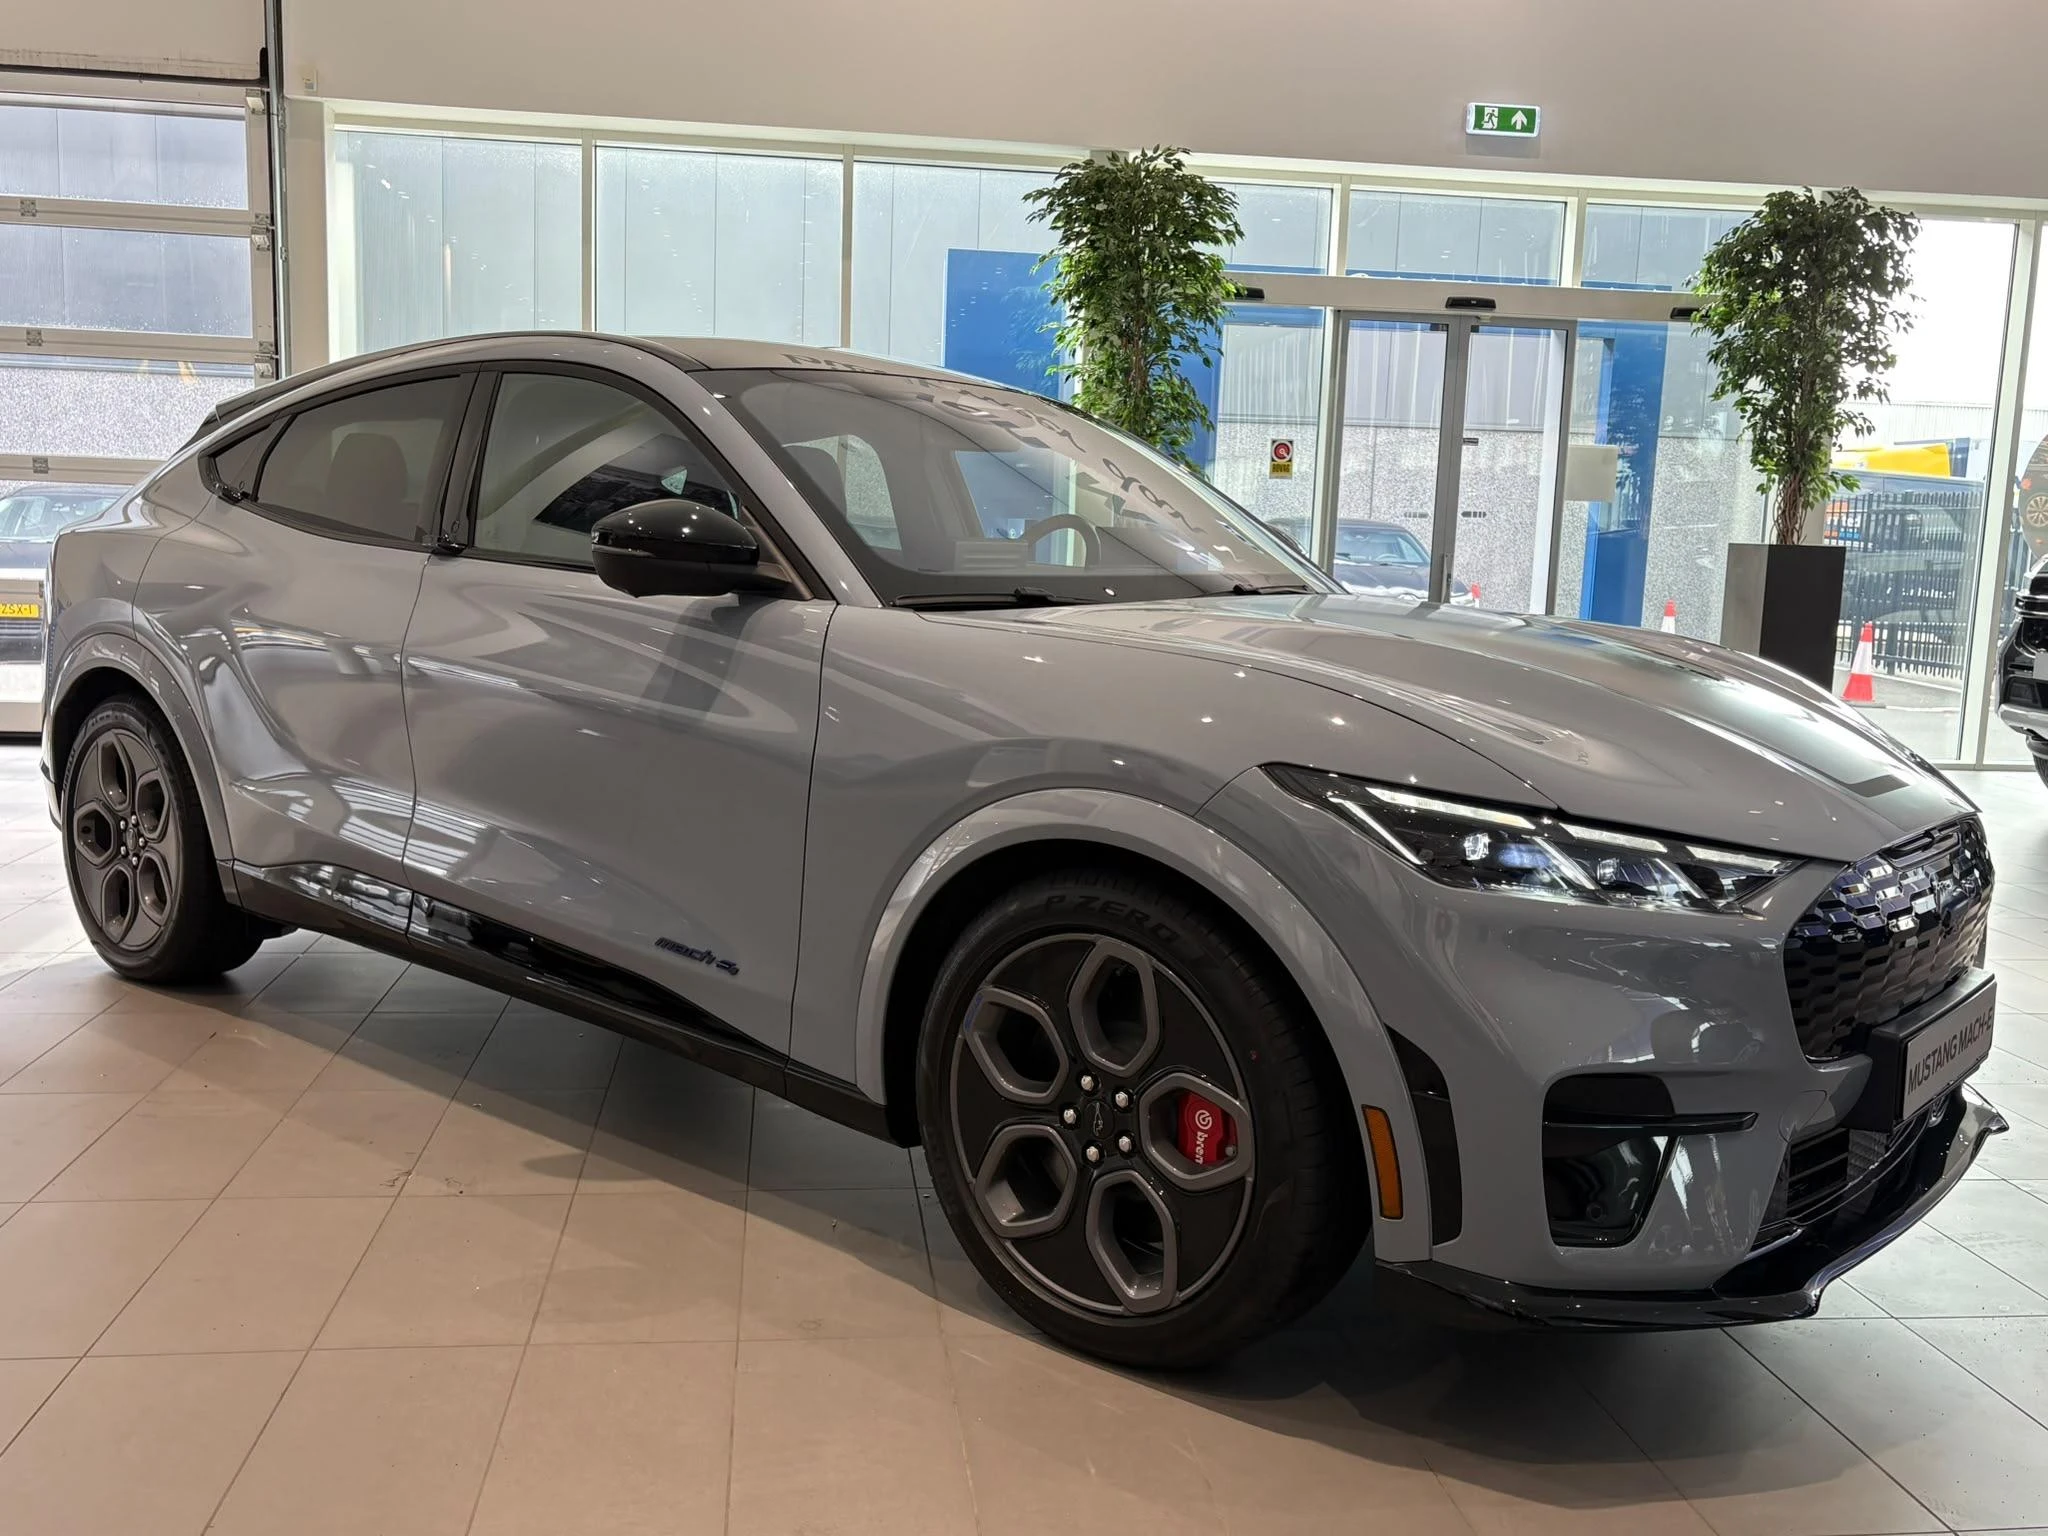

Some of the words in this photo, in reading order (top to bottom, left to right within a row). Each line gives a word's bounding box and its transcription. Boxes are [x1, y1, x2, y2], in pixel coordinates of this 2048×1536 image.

[1074, 896, 1181, 942] ZERO
[1907, 1033, 1958, 1096] MUSTANG
[1957, 1006, 1993, 1055] MACH-E
